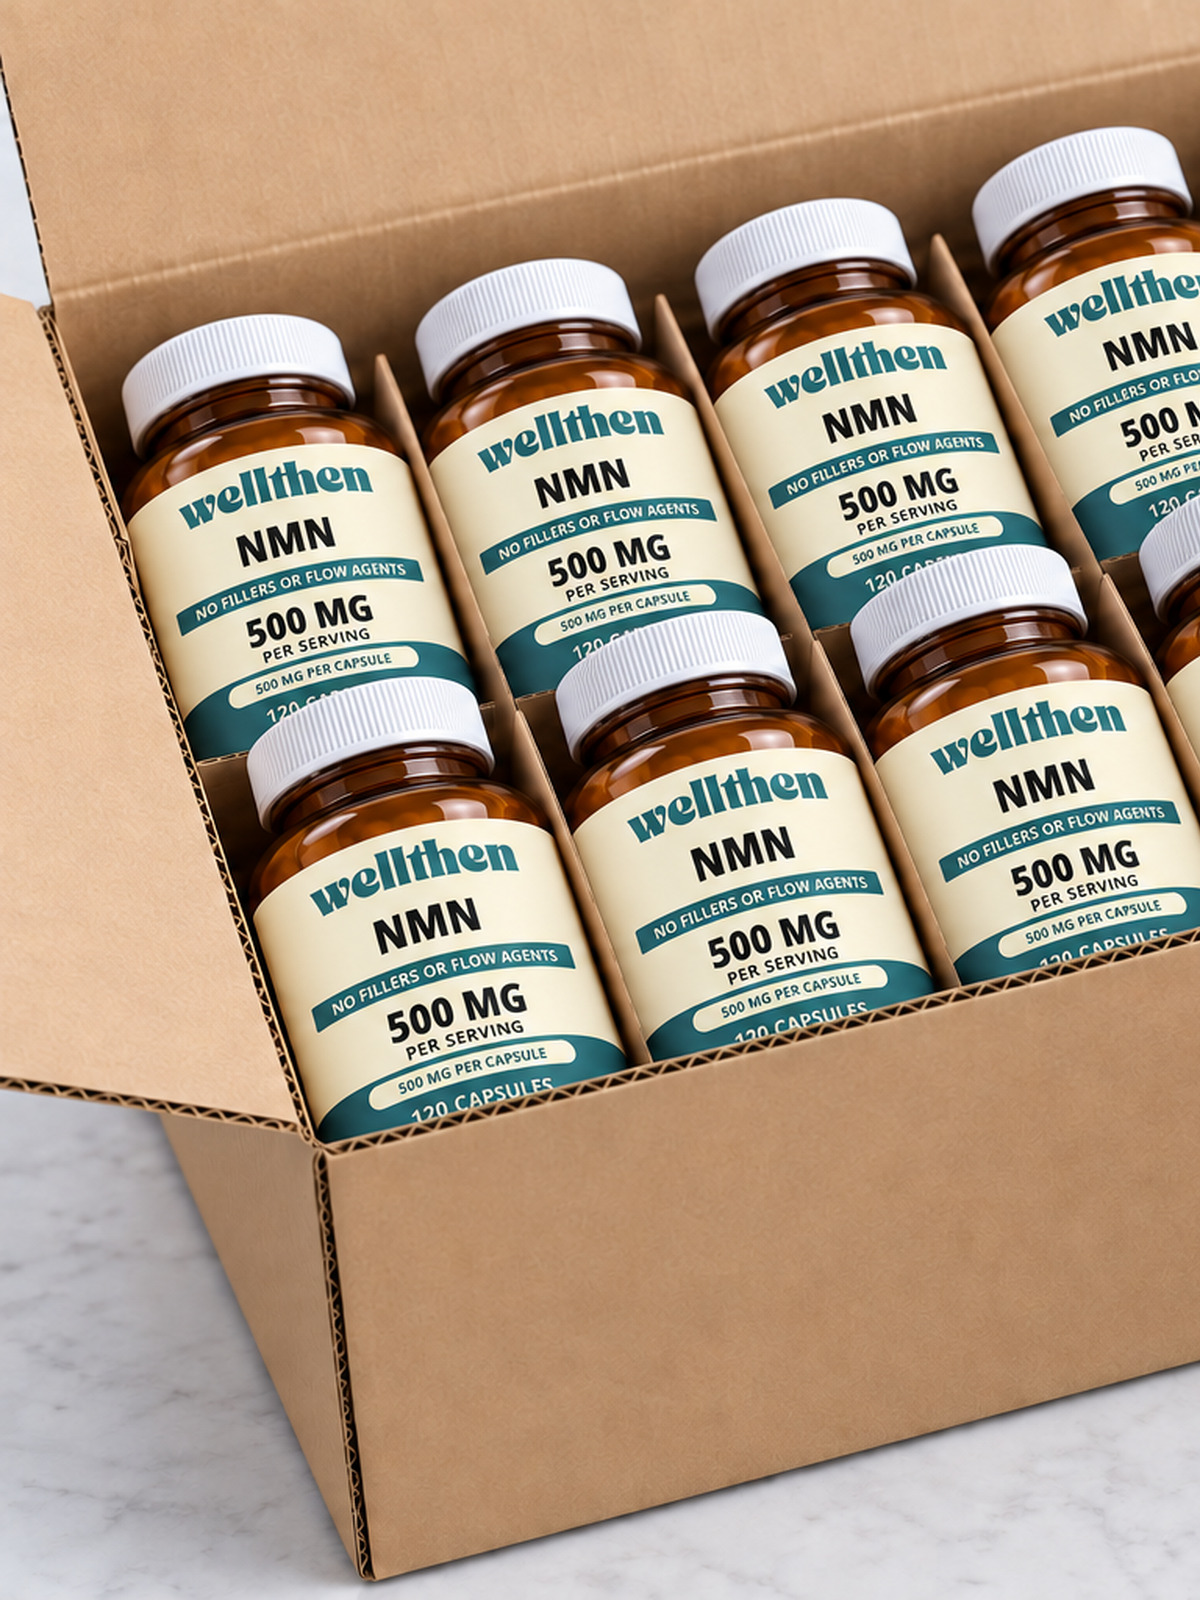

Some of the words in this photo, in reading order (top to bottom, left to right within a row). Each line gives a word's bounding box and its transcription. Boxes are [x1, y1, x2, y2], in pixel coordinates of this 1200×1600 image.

[1103, 322, 1198, 371] NMN
[764, 341, 947, 408] wellthen
[1070, 406, 1090, 422] NO
[1094, 384, 1146, 411] FILLERS
[1150, 377, 1170, 390] OR
[478, 405, 664, 472] wellthen
[822, 394, 917, 444] NMN
[1120, 407, 1179, 448] 500
[534, 459, 630, 508] NMN
[787, 478, 808, 494] NO
[812, 456, 864, 484] FILLERS
[868, 450, 889, 463] OR
[892, 440, 930, 457] FLOW
[936, 437, 984, 449] AGENTS
[179, 461, 373, 529] wellthen
[839, 480, 897, 521] 500
[903, 468, 959, 500] MG
[857, 517, 886, 535] PER
[890, 500, 957, 524] SERVING
[236, 517, 335, 567] NMN
[499, 542, 520, 560] NO
[524, 521, 576, 548] FILLERS
[579, 515, 600, 528] OR
[604, 507, 642, 522] FLOW
[648, 504, 699, 516] AGENTS
[548, 546, 607, 587] 500
[613, 534, 670, 567] MG
[196, 603, 218, 620] NO
[221, 583, 276, 610] FILLERS
[280, 575, 302, 588] OR
[306, 566, 346, 583] FLOW
[353, 563, 406, 576] AGENTS
[247, 607, 307, 648] 500
[314, 595, 373, 628] MG
[263, 645, 294, 663] PER
[298, 628, 370, 652] SERVING
[930, 701, 1126, 775] wellthen
[628, 768, 828, 843] wellthen
[993, 759, 1095, 813] NMN
[690, 826, 795, 882] NMN
[958, 850, 980, 868] NO
[983, 826, 1038, 856] FILLERS
[1042, 820, 1064, 835] OR
[1068, 811, 1108, 828] FLOW
[1114, 807, 1164, 820] AGENTS
[310, 839, 519, 916] wellthen
[1010, 853, 1073, 897] 500
[1080, 840, 1140, 875] MG
[1031, 892, 1063, 912] PER
[1067, 875, 1138, 900] SERVING
[373, 898, 481, 955] NMN
[654, 921, 677, 939] NO
[680, 897, 738, 927] FILLERS
[742, 890, 764, 905] OR
[768, 880, 809, 898] FLOW
[816, 877, 868, 890] AGENTS
[1026, 928, 1049, 944] 500
[1052, 919, 1074, 934] MG
[1078, 912, 1102, 926] PER
[1106, 900, 1161, 919] CAPSULE
[708, 924, 771, 968] 500
[778, 911, 840, 947] MG
[728, 965, 760, 985] PER
[764, 947, 838, 973] SERVING
[332, 996, 355, 1015] NO
[359, 970, 419, 1002] FILLERS
[424, 962, 447, 978] OR
[451, 952, 495, 971] FLOW
[502, 950, 558, 962] AGENTS
[722, 1002, 744, 1018] 500
[748, 992, 771, 1008] MG
[775, 985, 800, 1000] PER
[803, 973, 861, 992] CAPSULE
[387, 997, 453, 1044] 500
[462, 983, 527, 1020] MG
[406, 1039, 440, 1060] PER
[446, 1020, 524, 1047] SERVING
[398, 1076, 423, 1094] 500
[427, 1068, 451, 1084] MG
[455, 1060, 482, 1075] PER
[486, 1048, 547, 1067] CAPSULE
